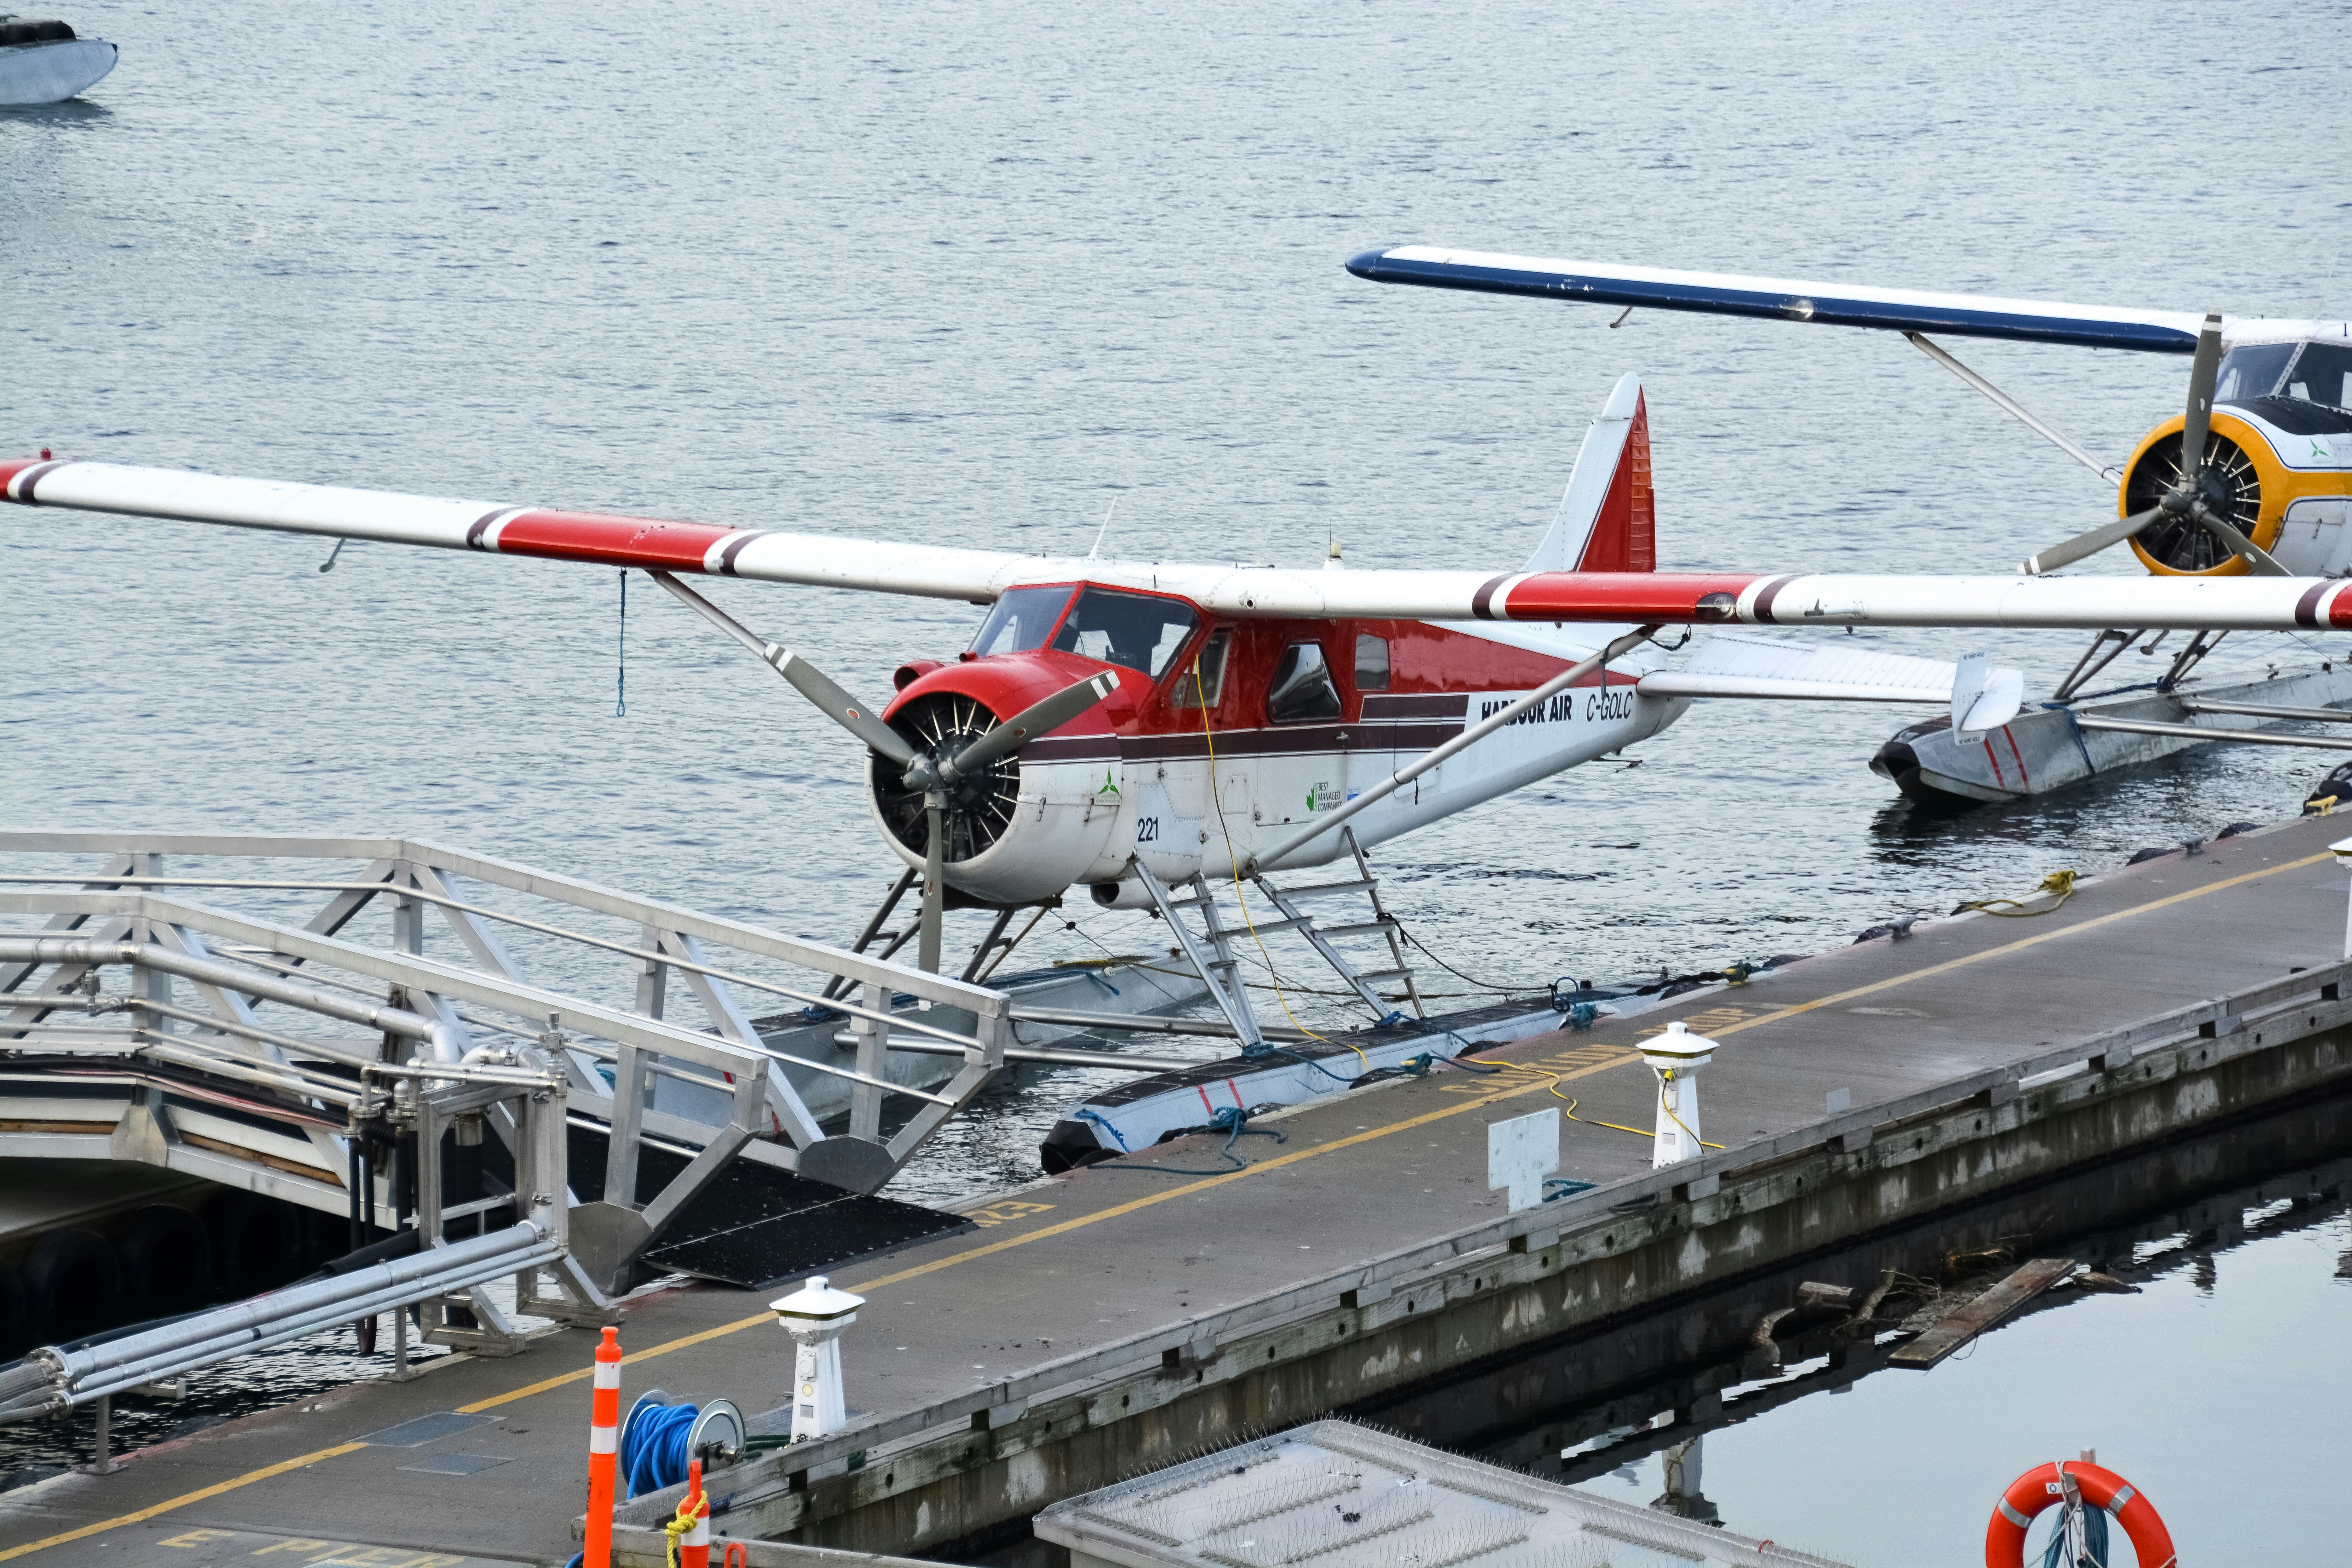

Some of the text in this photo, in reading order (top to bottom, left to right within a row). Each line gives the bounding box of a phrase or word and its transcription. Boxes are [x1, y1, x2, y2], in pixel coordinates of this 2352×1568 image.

[1549, 695, 1572, 722] AIR
[1587, 691, 1633, 722] C-GOLC
[1318, 782, 1328, 791] BEST
[1318, 791, 1341, 801] MANAGED
[1138, 817, 1158, 843] 221
[1439, 1043, 1640, 1094] CAUTION
